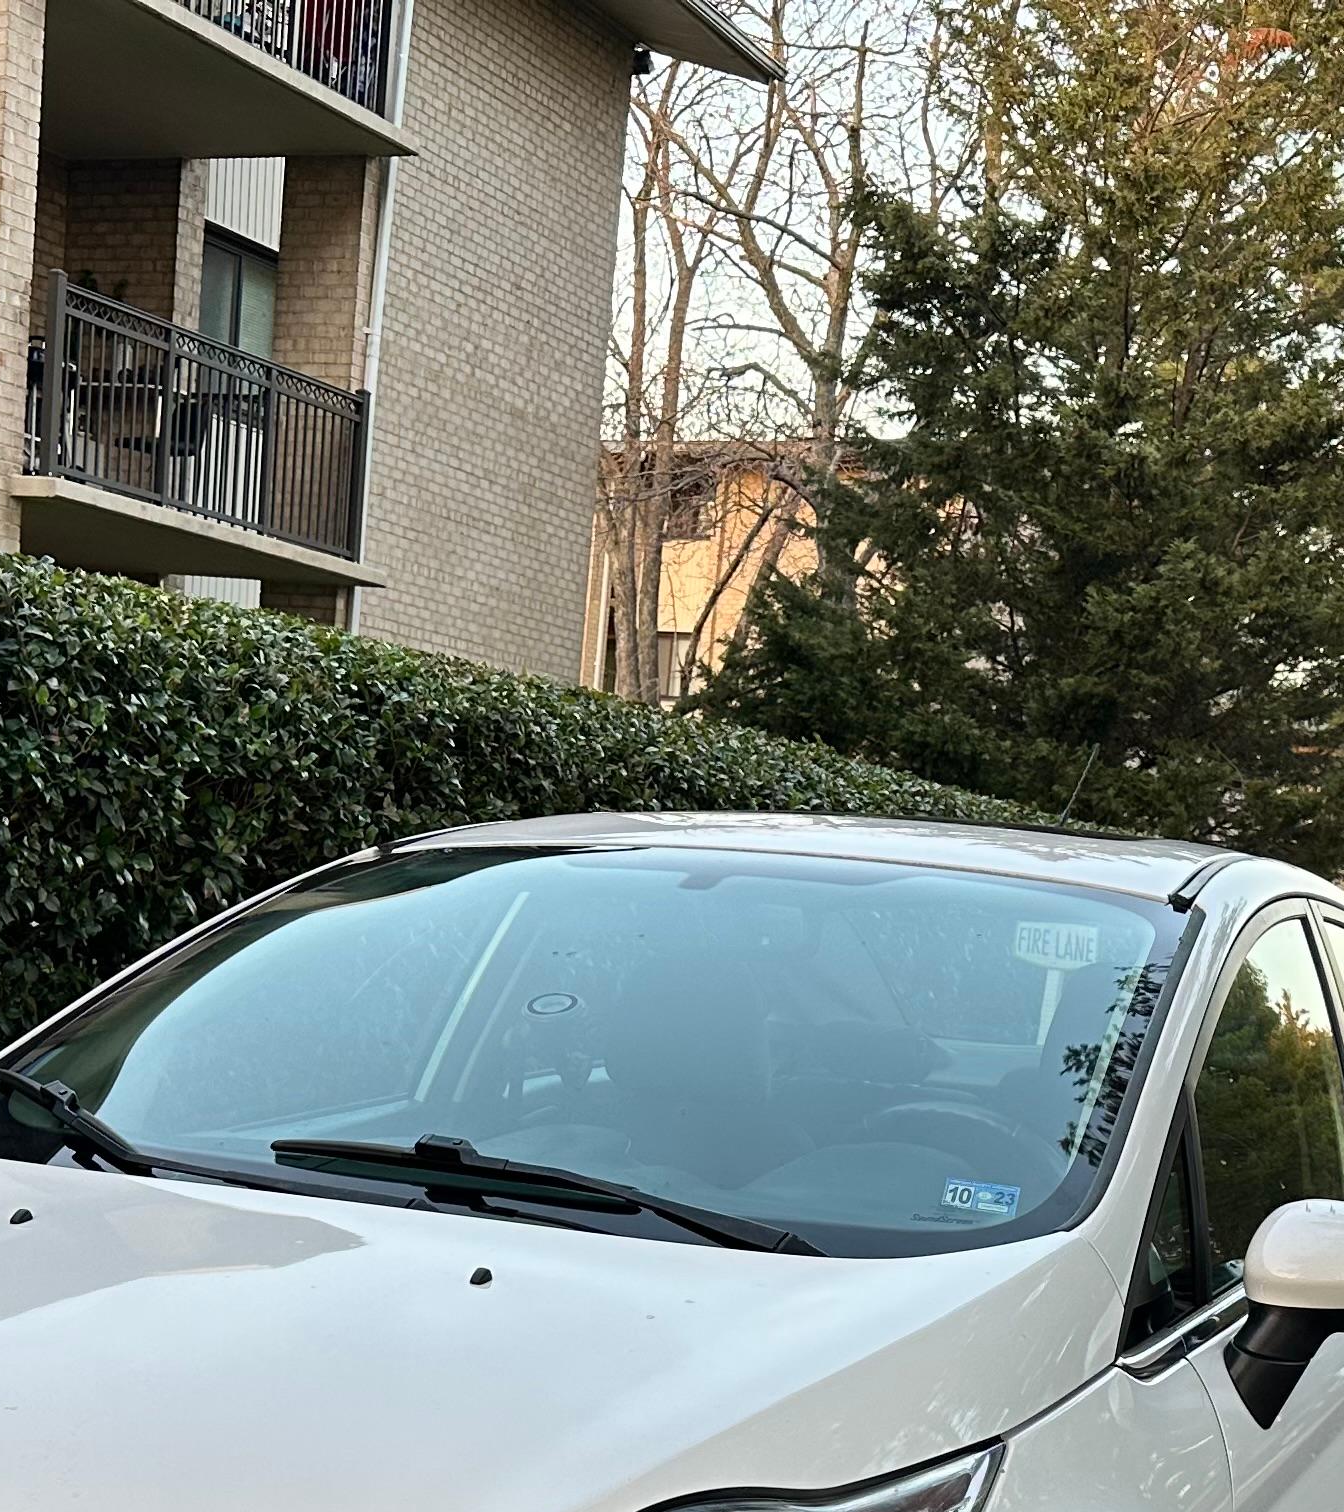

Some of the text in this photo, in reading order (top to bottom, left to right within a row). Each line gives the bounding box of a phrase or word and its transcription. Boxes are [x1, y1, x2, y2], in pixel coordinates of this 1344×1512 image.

[1018, 927, 1095, 962] FIRE LANE
[948, 1186, 1016, 1206] 10 23
